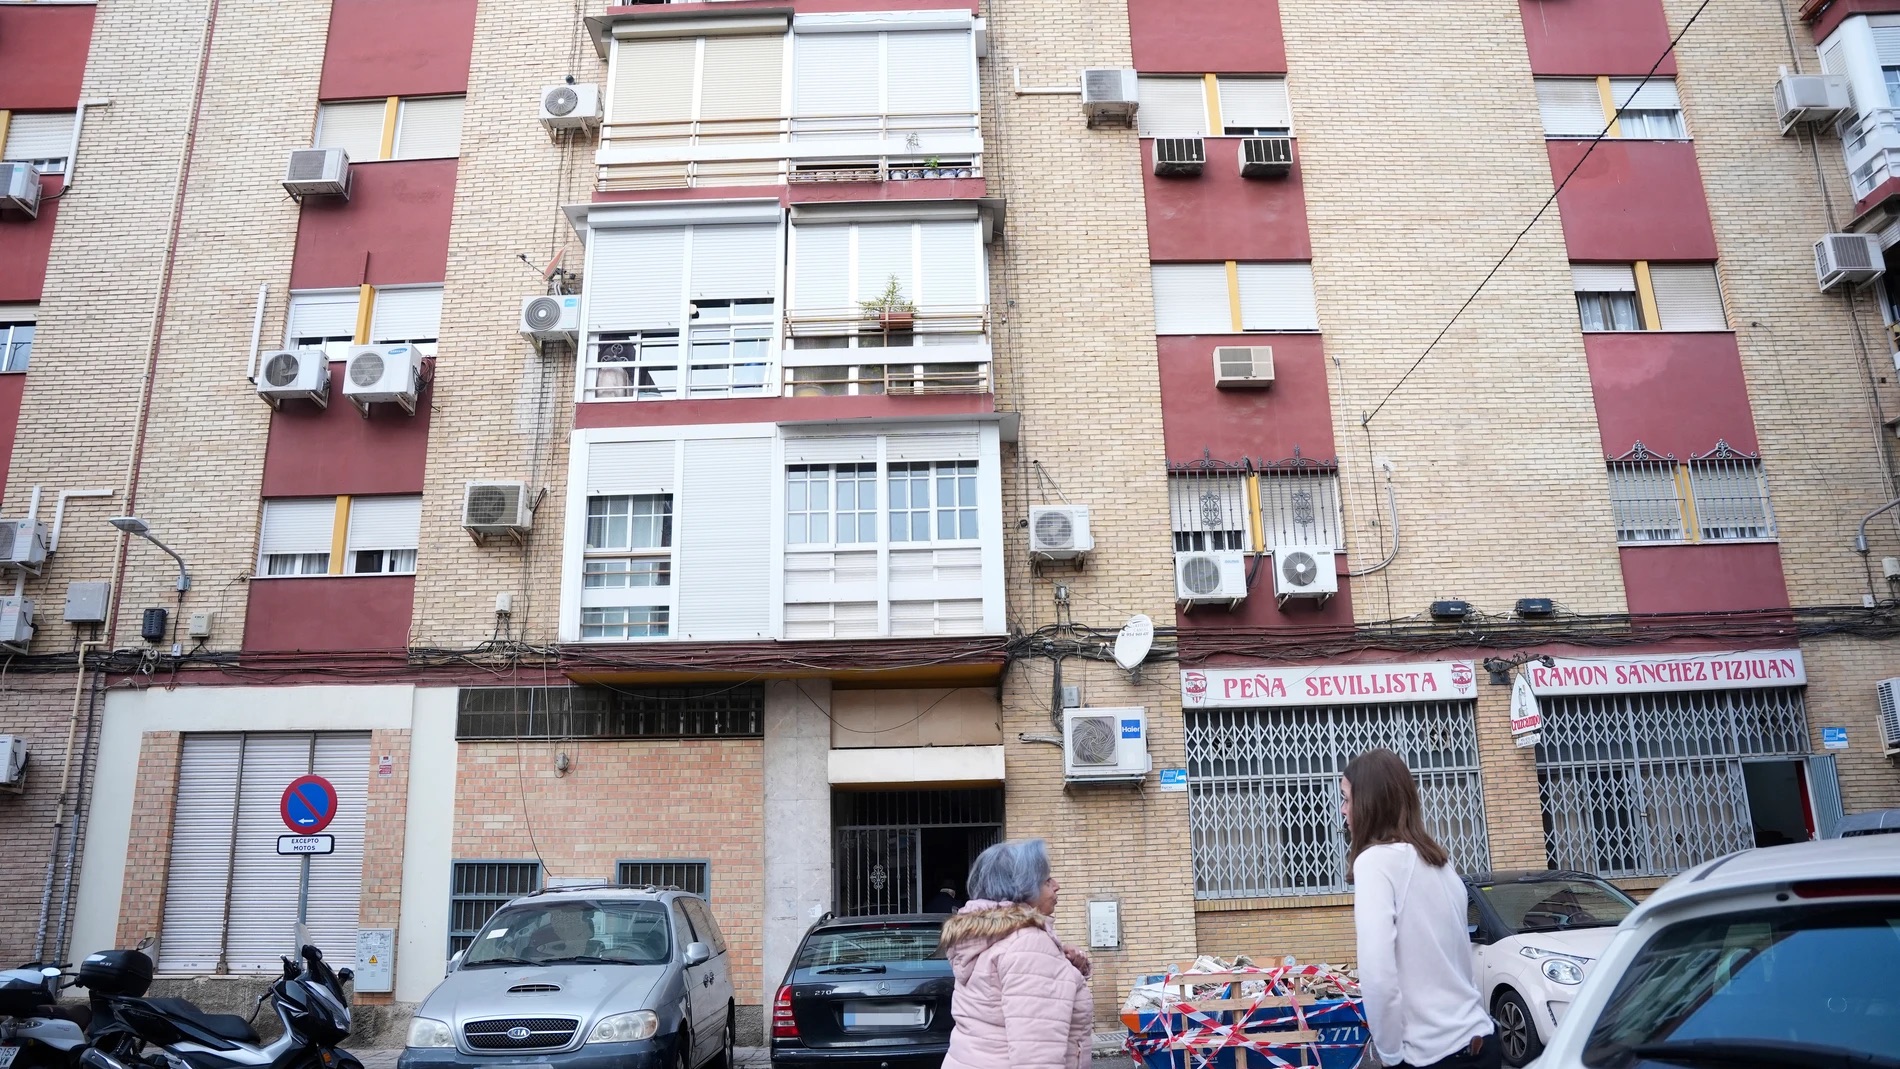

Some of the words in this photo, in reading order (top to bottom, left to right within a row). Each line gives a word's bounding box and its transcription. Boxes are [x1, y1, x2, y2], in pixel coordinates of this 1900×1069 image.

[1533, 666, 1608, 688] RAMON
[1615, 661, 1707, 685] SANCHEZ
[1711, 658, 1795, 681] PIZJUAN
[1223, 674, 1286, 698] PEÑA
[1305, 672, 1438, 696] SEVILLISTA
[1511, 714, 1540, 731] Cruzcampo
[1330, 1026, 1359, 1042] 771
[0, 1047, 16, 1056] 153
